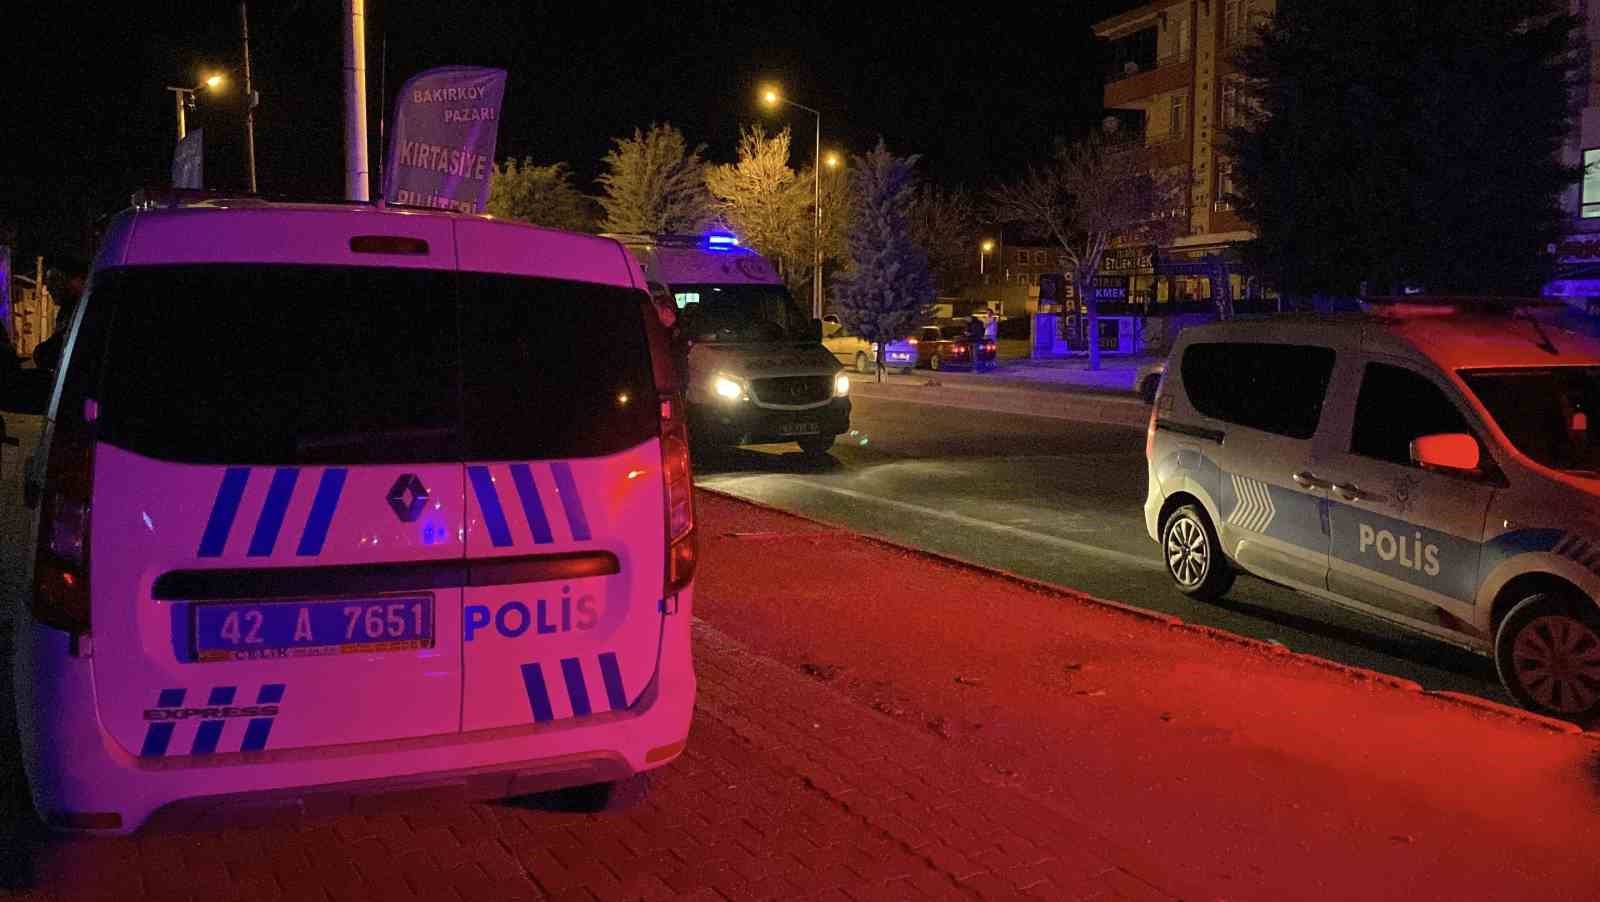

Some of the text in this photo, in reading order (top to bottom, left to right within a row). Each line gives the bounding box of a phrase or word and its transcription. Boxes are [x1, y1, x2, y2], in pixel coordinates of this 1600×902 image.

[1359, 522, 1440, 577] POLİS
[220, 602, 422, 644] 42 A 7651
[463, 584, 598, 642] POLİS
[143, 705, 280, 721] EXPRESS
